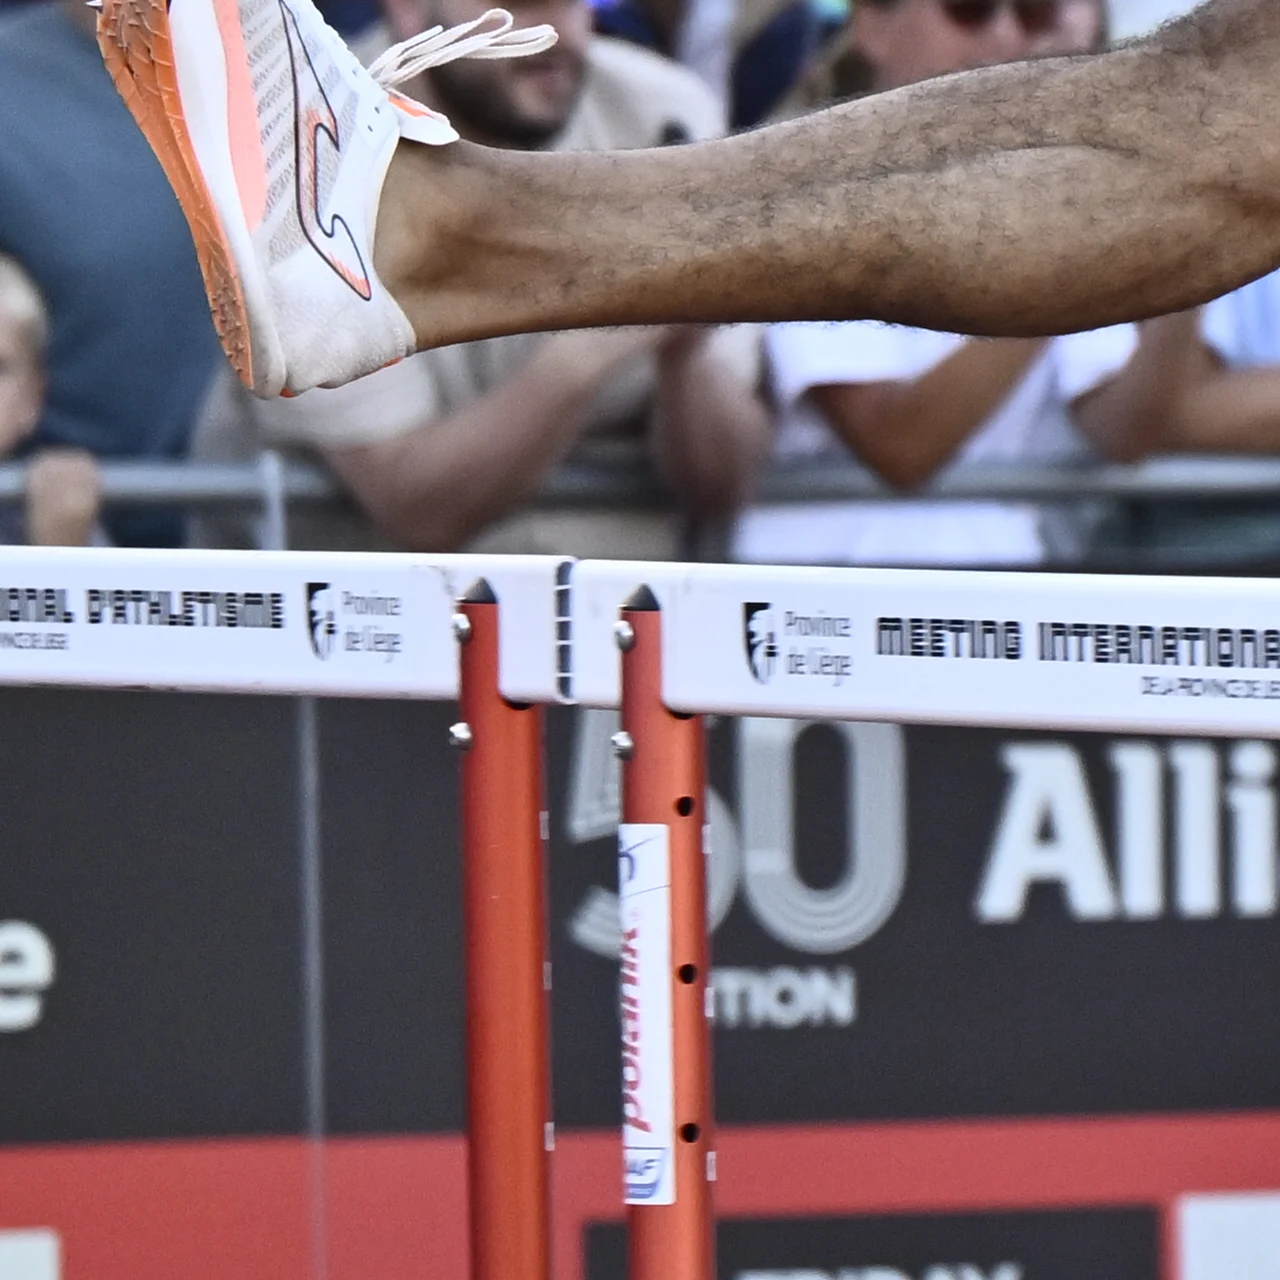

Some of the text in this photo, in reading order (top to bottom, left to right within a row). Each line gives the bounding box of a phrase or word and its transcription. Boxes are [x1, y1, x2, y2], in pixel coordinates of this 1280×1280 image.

[784, 609, 850, 638] Province
[875, 617, 1022, 660] MEETING
[708, 967, 857, 1028] TION
